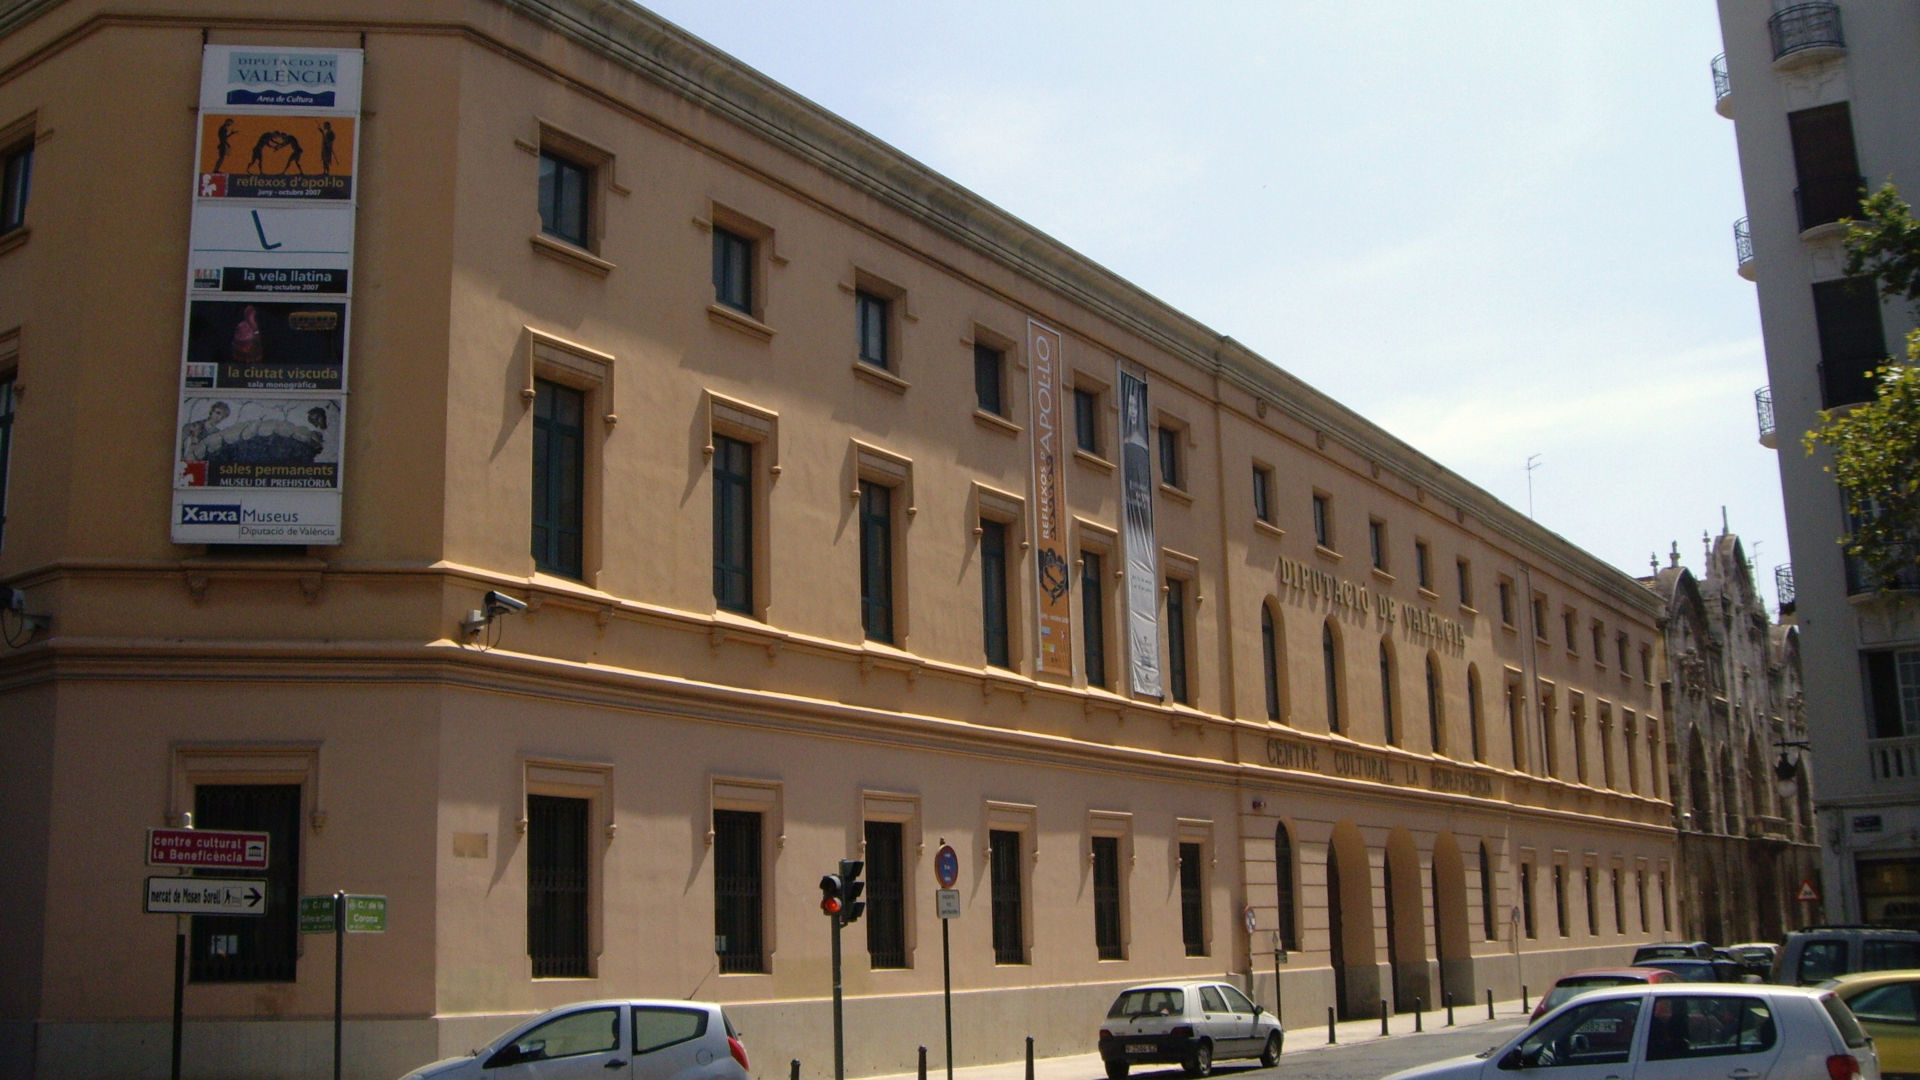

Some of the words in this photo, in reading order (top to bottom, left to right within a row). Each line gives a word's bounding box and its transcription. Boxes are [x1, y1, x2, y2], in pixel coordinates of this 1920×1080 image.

[319, 59, 335, 67] DE
[276, 95, 285, 103] de
[286, 95, 314, 103] Cultura
[236, 176, 287, 188] reflexos
[243, 269, 255, 281] la
[259, 269, 287, 282] vela
[290, 270, 332, 283] llatina
[301, 284, 320, 292] 2007
[227, 366, 240, 378] la
[243, 366, 284, 379] ciutat
[287, 367, 338, 380] viscuda
[247, 381, 264, 389] sala
[219, 462, 251, 475] sales
[254, 463, 333, 477] permanents
[219, 477, 254, 487] MUSEU
[255, 478, 267, 487] DE
[1040, 465, 1049, 540] REFLEXOS
[183, 506, 238, 522] Xarxa
[242, 509, 299, 523] Museus
[240, 526, 284, 538] Diputació
[287, 526, 298, 536] de
[299, 526, 335, 537] València
[1278, 555, 1369, 614] DIPUTACIÓ
[1376, 592, 1397, 624] DE
[1266, 737, 1320, 771] CENTRE
[1333, 751, 1395, 783] CULTURAL
[1404, 762, 1419, 786] LA
[153, 837, 192, 848] centre
[196, 837, 242, 849] cultural
[153, 848, 164, 859] la
[151, 888, 172, 904] mercat
[173, 888, 181, 903] de
[203, 888, 221, 905] Sorell
